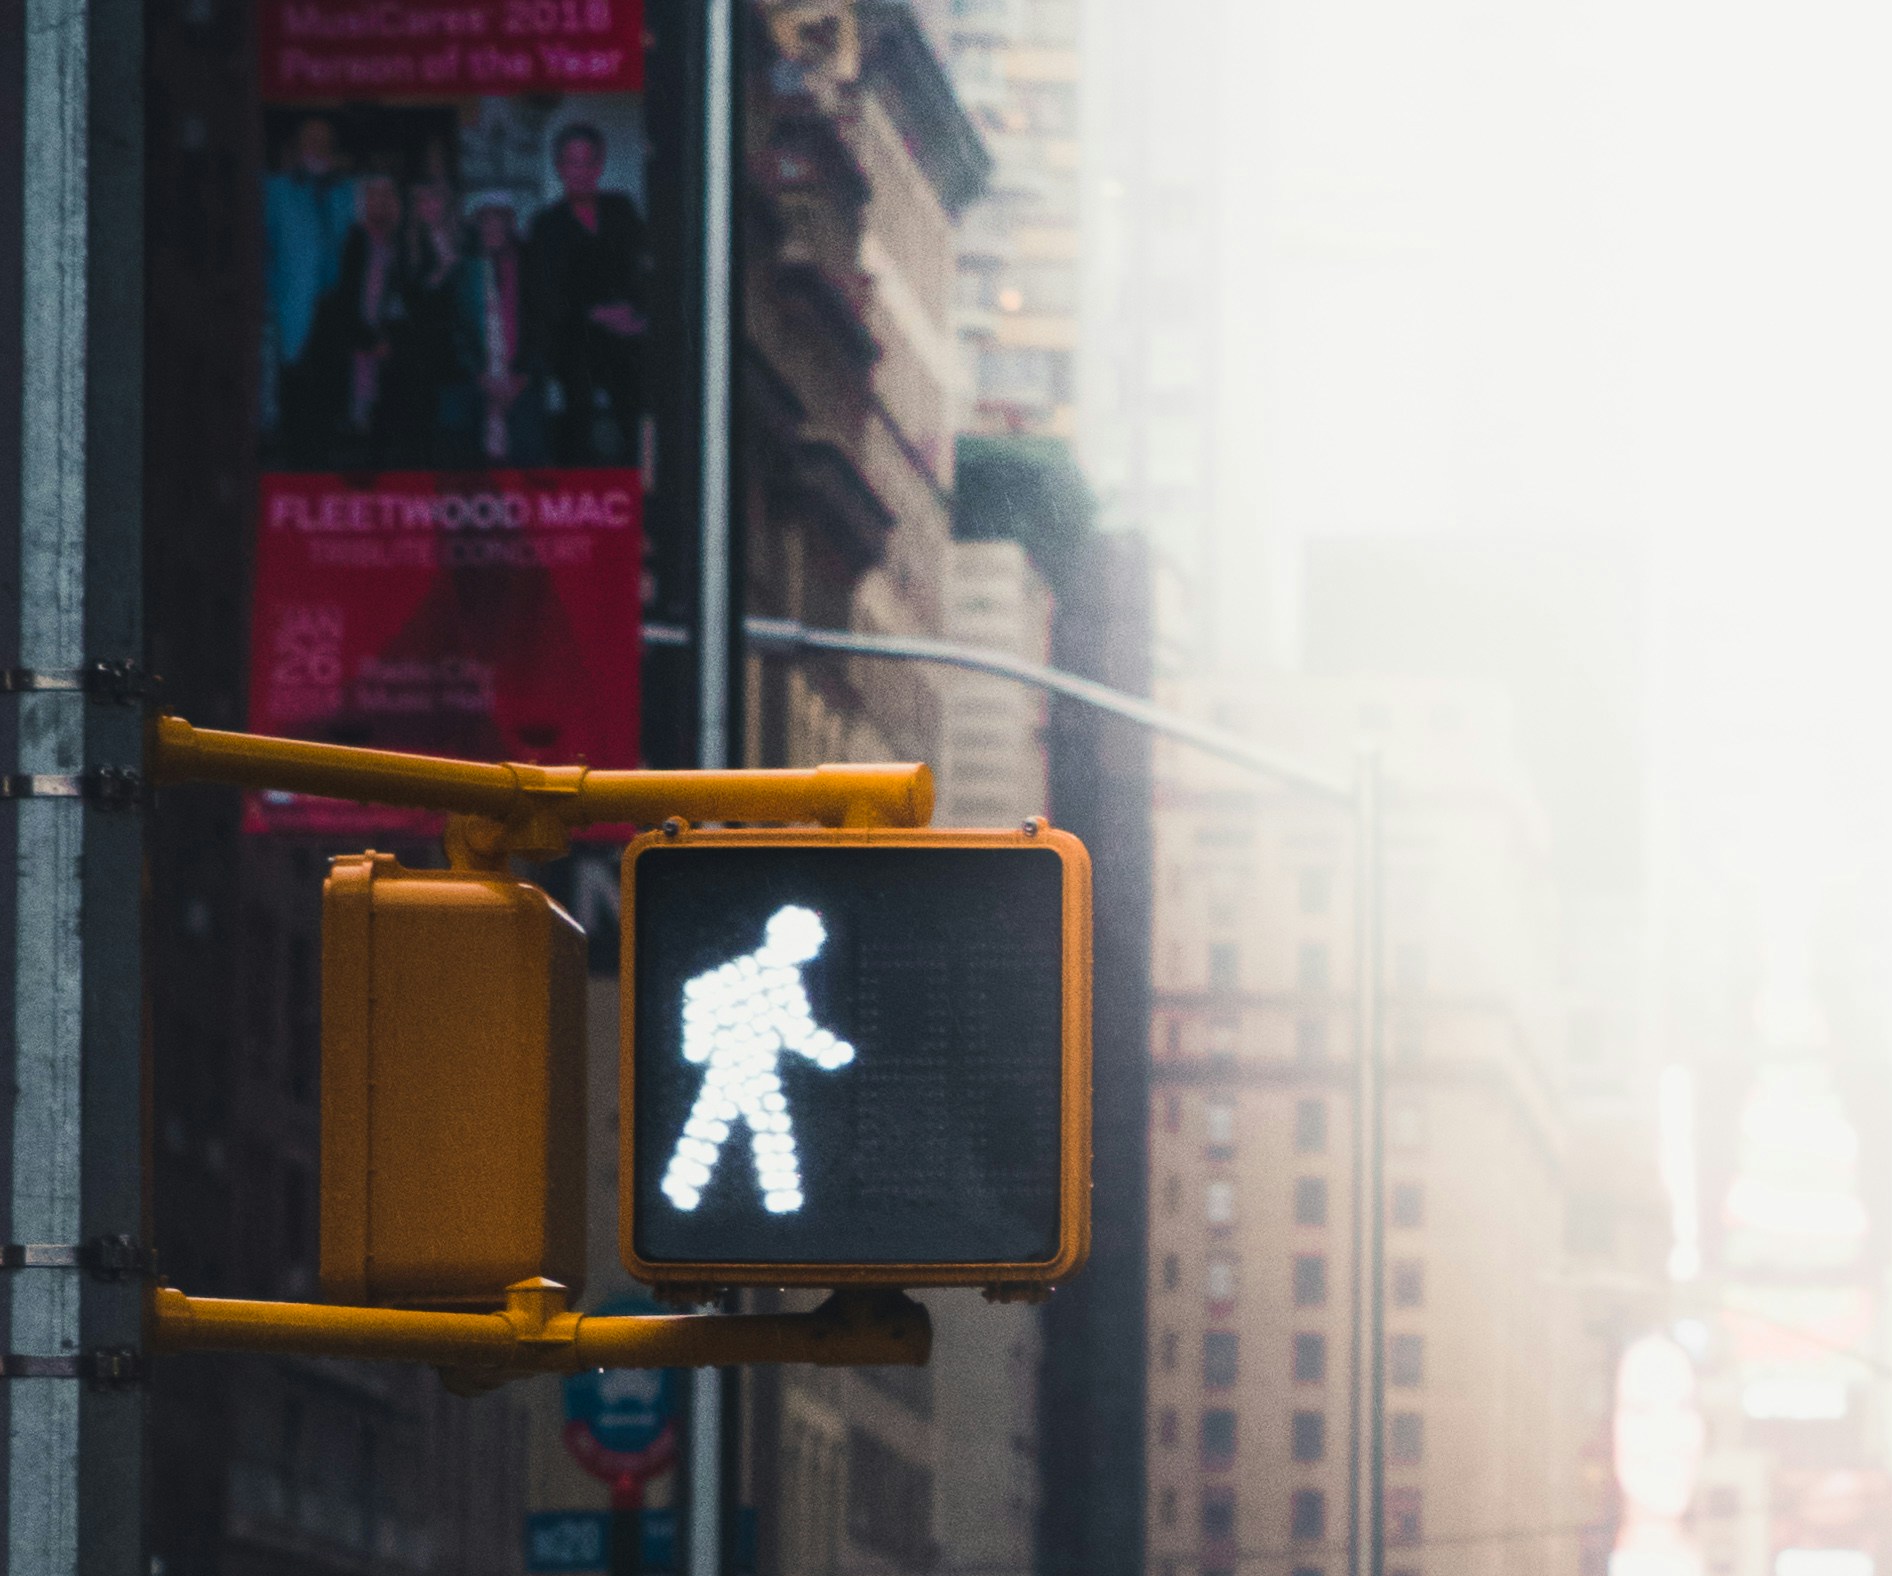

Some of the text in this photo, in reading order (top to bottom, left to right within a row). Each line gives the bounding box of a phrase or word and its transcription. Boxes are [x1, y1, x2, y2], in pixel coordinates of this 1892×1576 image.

[278, 42, 625, 84] Person of the Year
[269, 488, 632, 532] FLEETWOOD MAC
